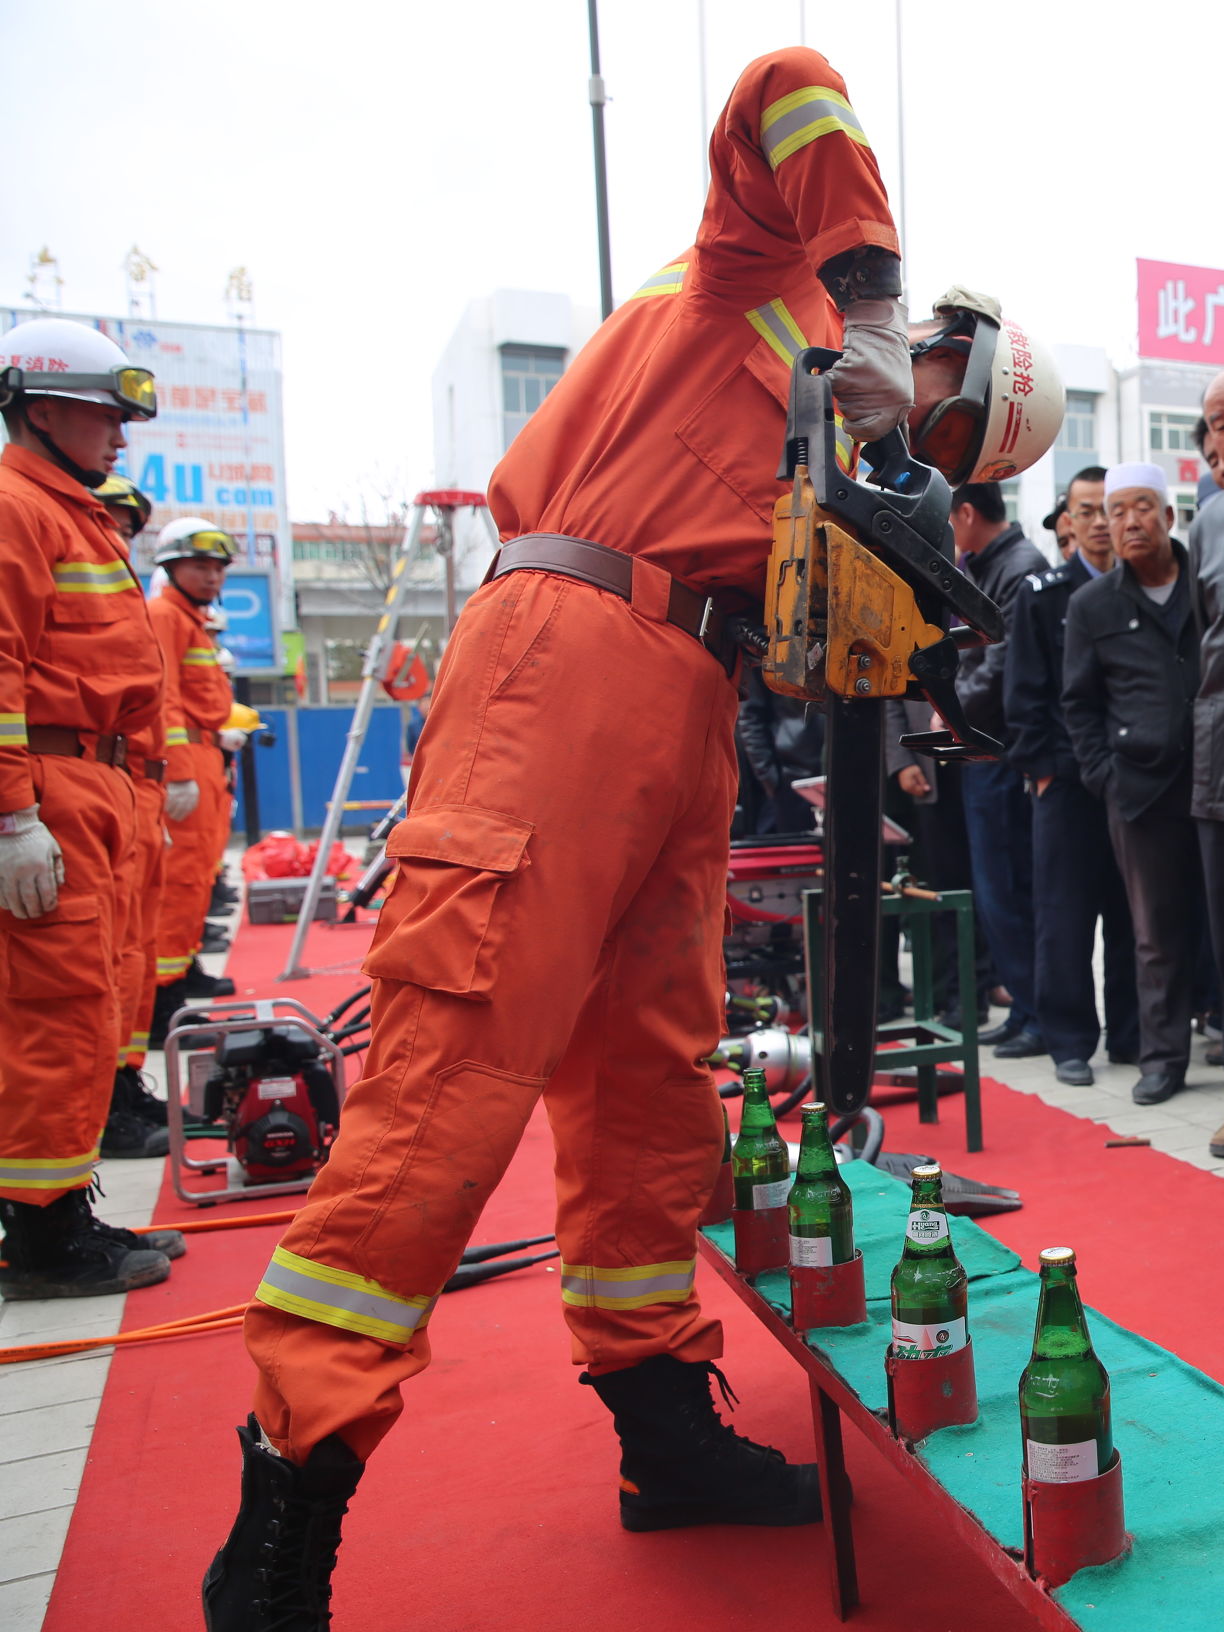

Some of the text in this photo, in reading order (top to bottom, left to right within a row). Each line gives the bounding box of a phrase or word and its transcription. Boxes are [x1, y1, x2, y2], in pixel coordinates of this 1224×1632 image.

[0, 354, 70, 372] 夏消防
[116, 452, 204, 503] 4u
